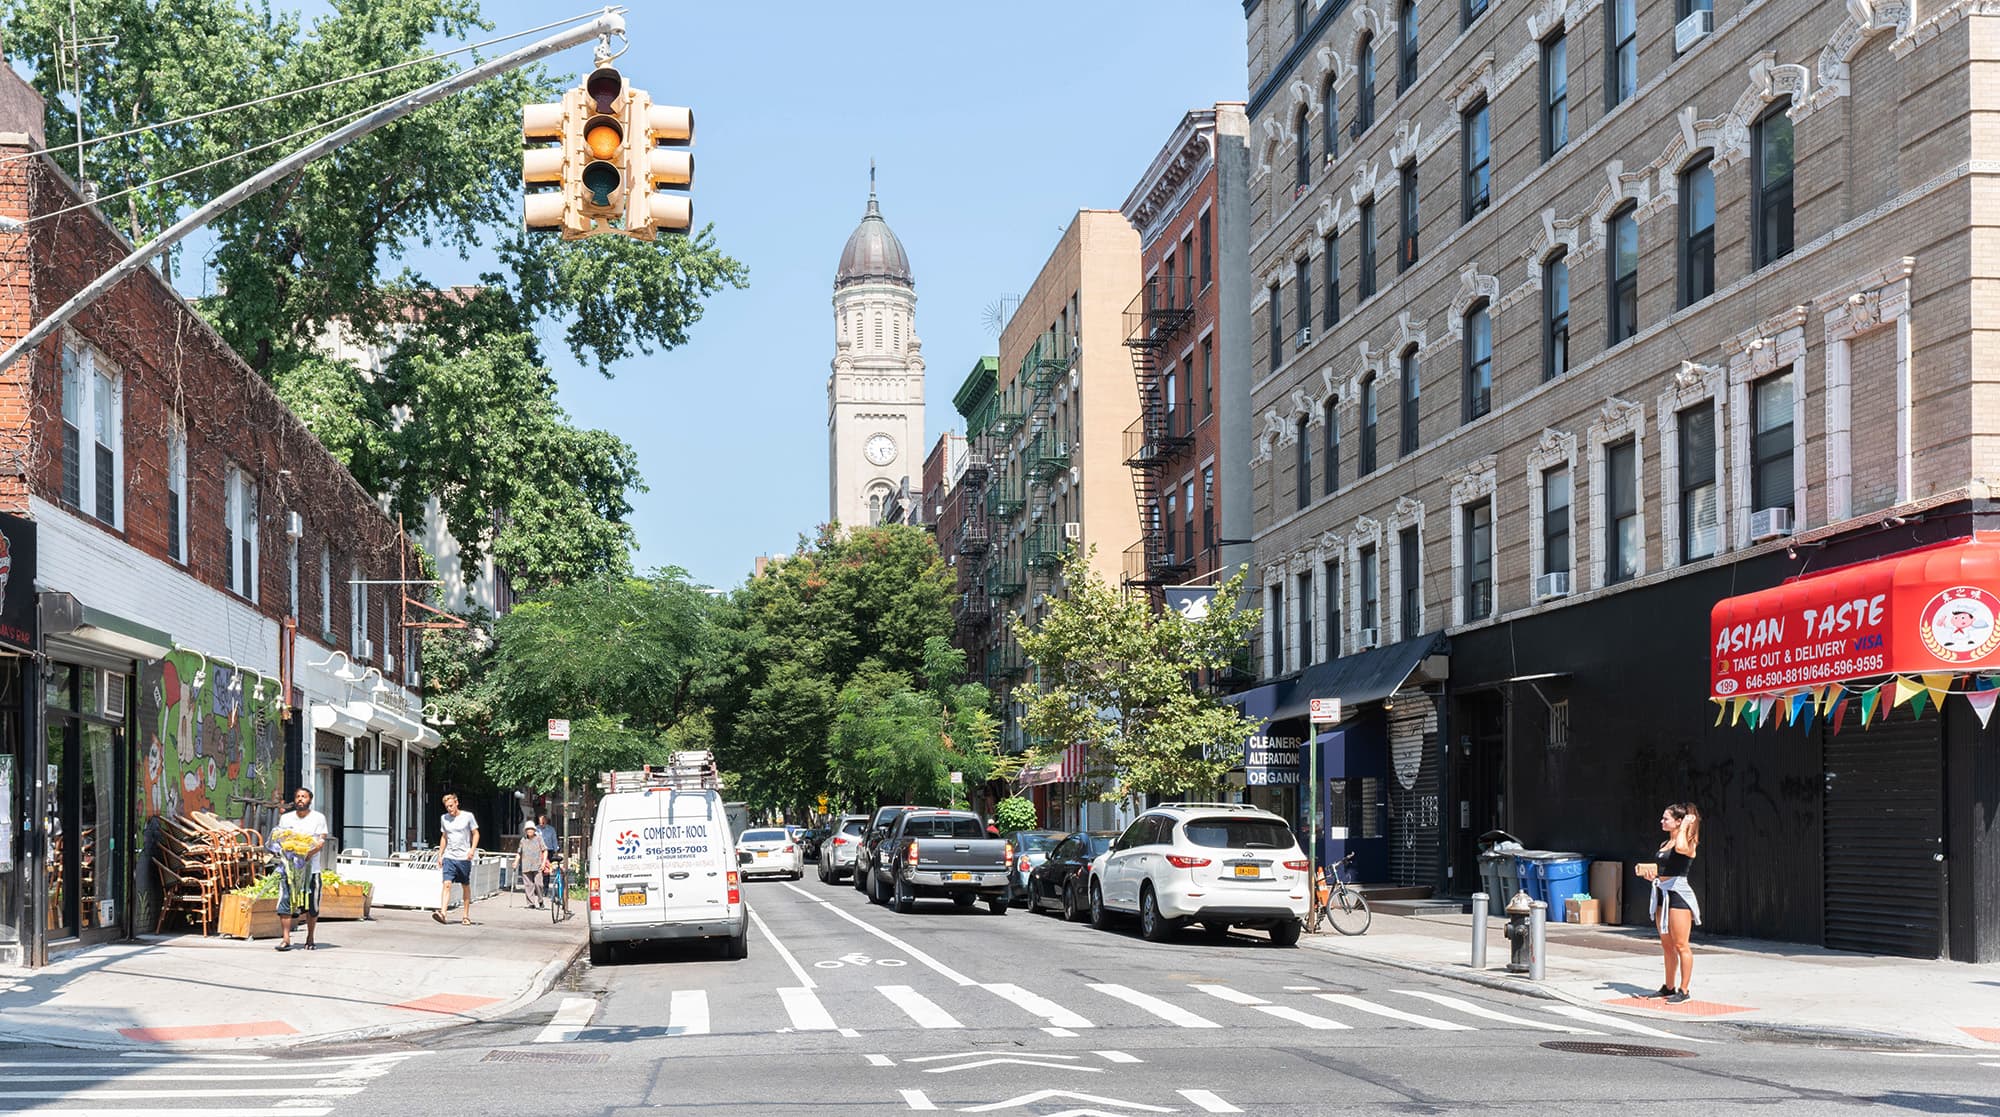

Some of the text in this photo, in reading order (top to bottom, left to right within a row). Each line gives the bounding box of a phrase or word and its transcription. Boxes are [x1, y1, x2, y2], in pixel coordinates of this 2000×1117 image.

[1716, 594, 1886, 658] ASIAN TASTE
[1853, 633, 1883, 650] VISA
[1733, 639, 1847, 672] TAKE OUT & DELIVERY
[1745, 654, 1884, 690] 646-590-8819/646-596-9595
[1719, 680, 1734, 692] 199
[1249, 735, 1301, 749] CLEANERS
[645, 845, 708, 855] 516-595-7003
